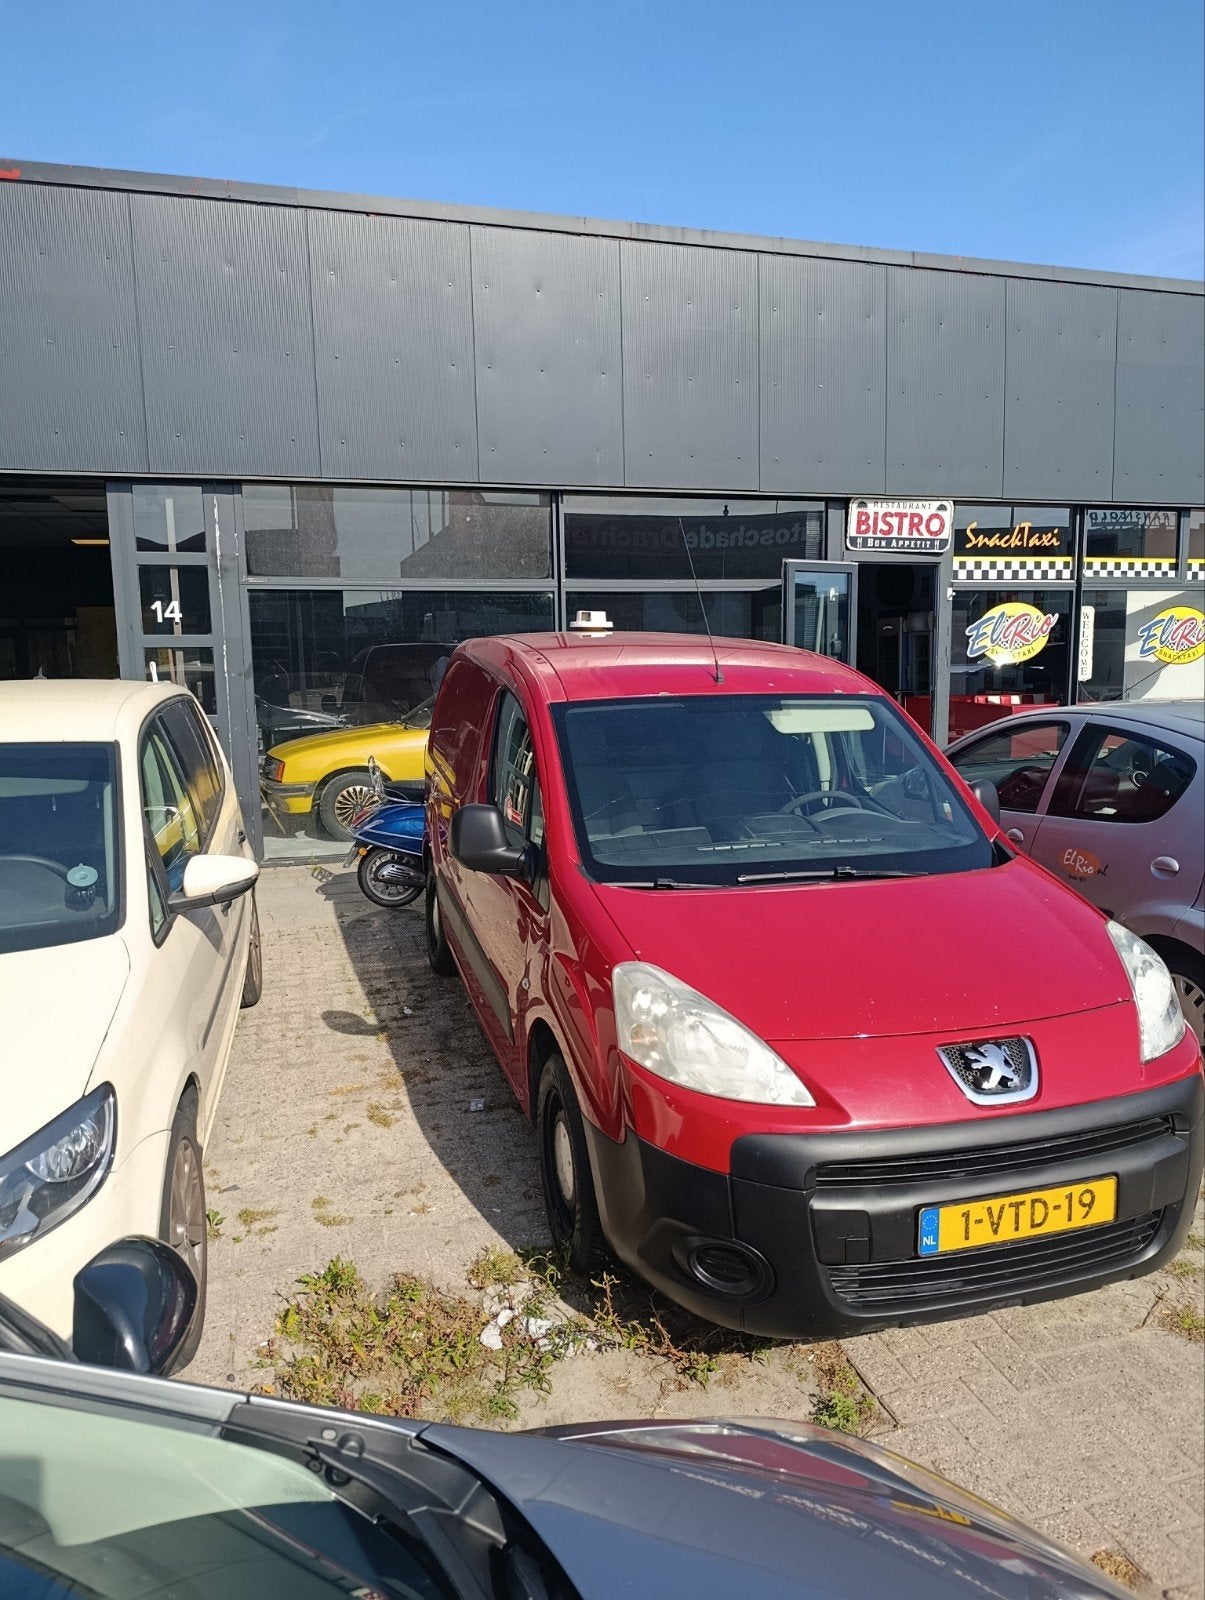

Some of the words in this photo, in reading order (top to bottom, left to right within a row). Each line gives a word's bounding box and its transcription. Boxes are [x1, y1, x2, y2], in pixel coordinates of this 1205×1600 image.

[873, 501, 931, 510] RESTAURANT
[965, 521, 1061, 549] SnackTaxi
[150, 600, 183, 623] 14
[1080, 611, 1090, 676] WELCOME
[961, 1188, 1097, 1241] 1-VTD-19
[922, 1235, 937, 1246] NL
